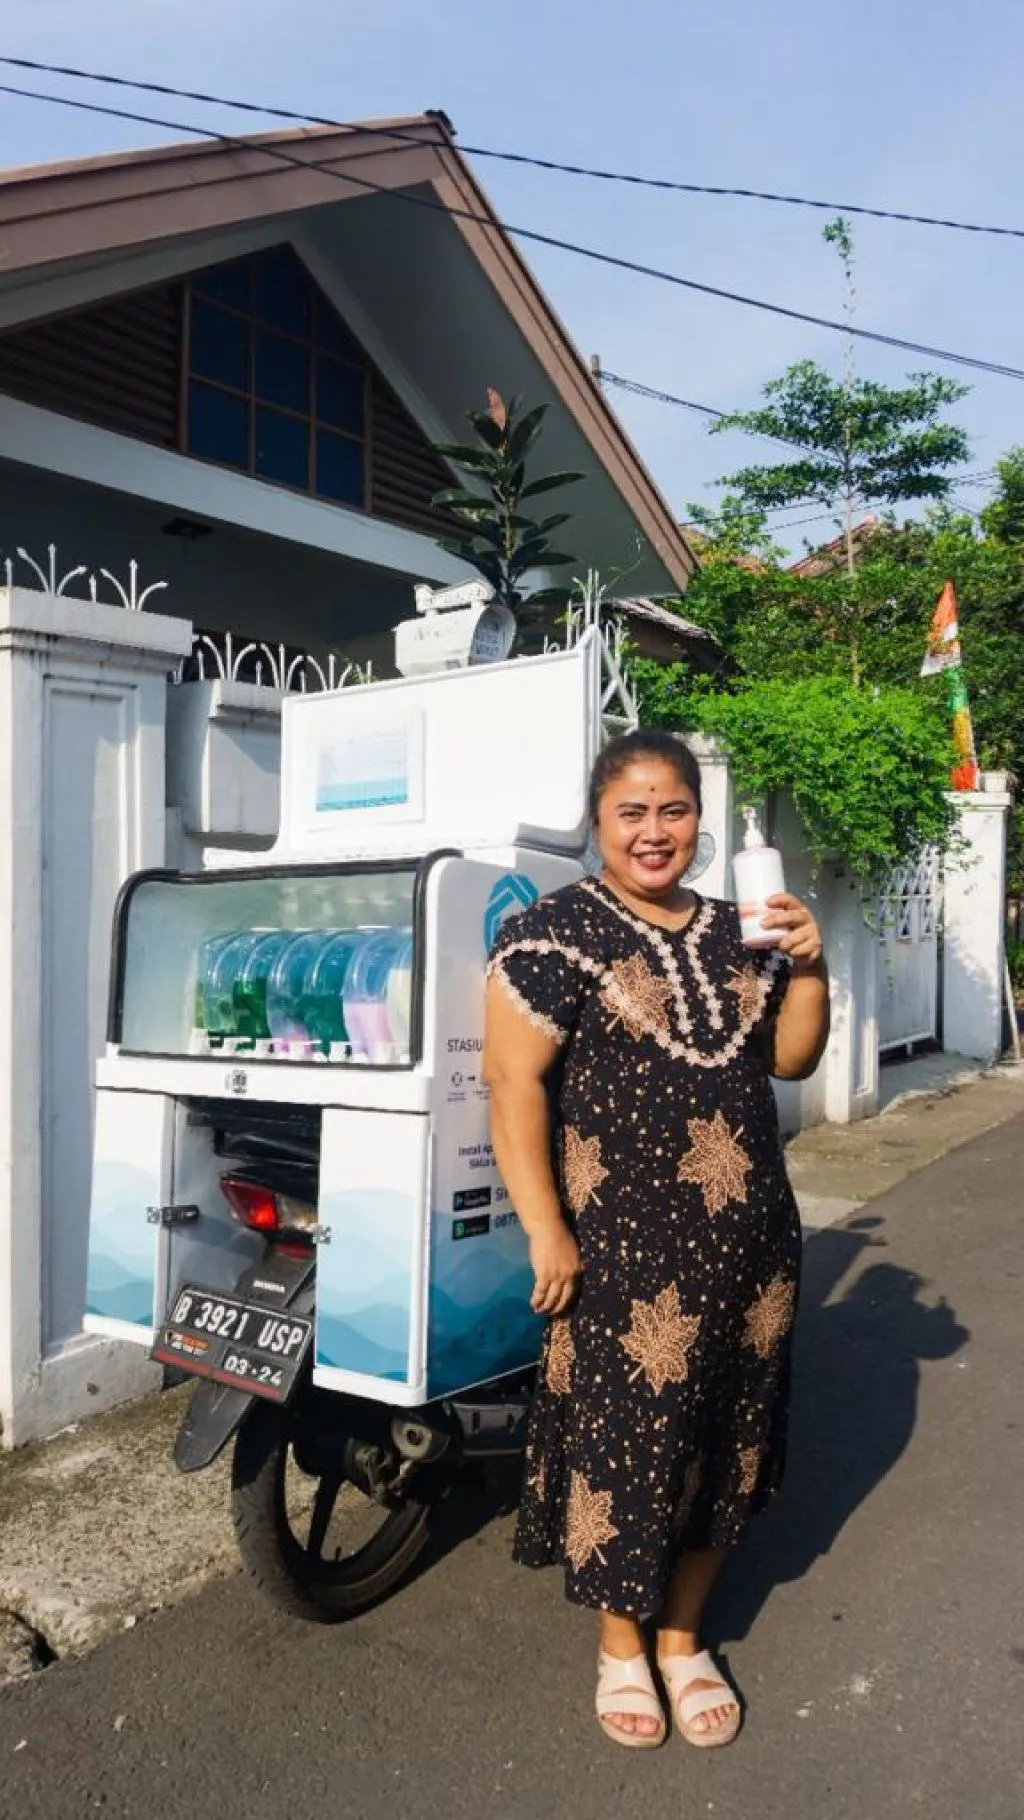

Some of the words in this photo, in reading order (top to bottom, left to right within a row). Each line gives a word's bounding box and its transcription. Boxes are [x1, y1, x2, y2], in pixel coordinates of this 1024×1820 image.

[173, 1296, 193, 1324] B
[194, 1302, 249, 1340] 3921
[257, 1319, 304, 1356] USP
